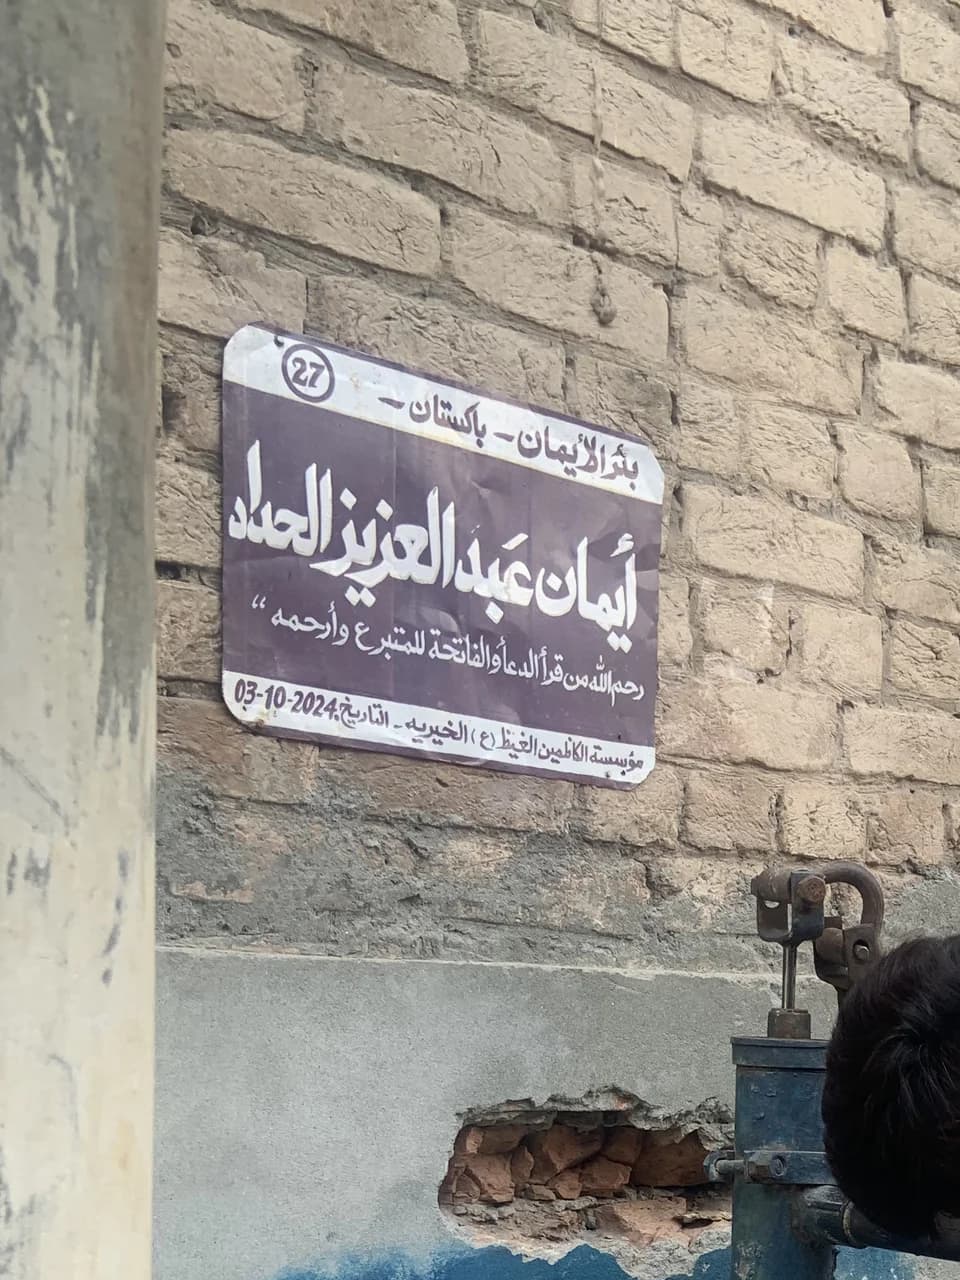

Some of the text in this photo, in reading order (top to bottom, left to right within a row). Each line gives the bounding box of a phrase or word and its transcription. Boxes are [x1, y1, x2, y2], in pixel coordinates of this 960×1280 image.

[291, 356, 326, 388] 27
[409, 394, 487, 449] باكستان
[607, 443, 640, 491] بئر
[228, 439, 333, 557] الحداد
[309, 486, 455, 608] العزيز
[270, 600, 349, 646] وأرحمه
[540, 645, 564, 686] قرأ
[562, 670, 589, 691] من
[588, 655, 613, 695] الله
[234, 678, 337, 722] 03-10-2024
[611, 678, 645, 707] رحم
